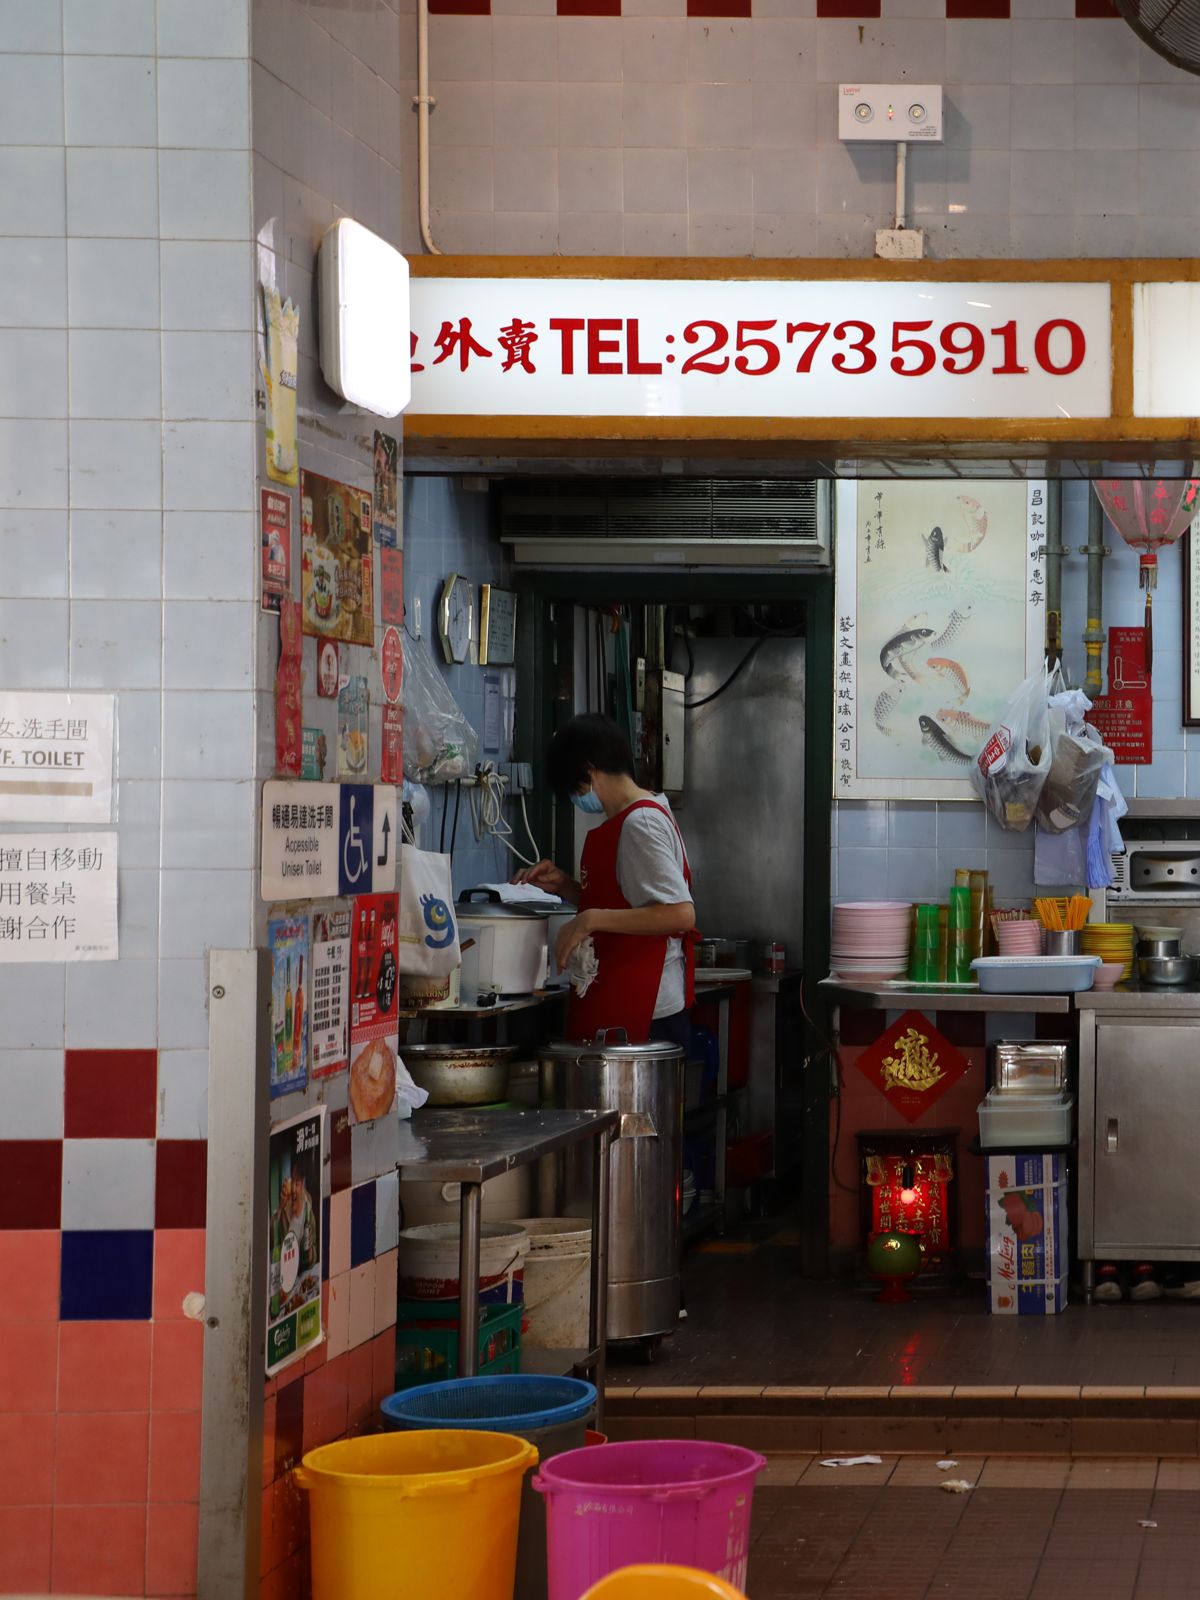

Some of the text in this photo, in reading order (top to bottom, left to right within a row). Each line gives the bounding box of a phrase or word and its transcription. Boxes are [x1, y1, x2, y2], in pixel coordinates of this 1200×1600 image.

[22, 751, 84, 767] TOILET
[285, 836, 320, 854] Accessible
[0, 848, 103, 872] 擅自移動
[281, 859, 322, 878] Unisex Toilet
[0, 881, 76, 906] 用餐桌
[0, 915, 76, 941] 謝合作
